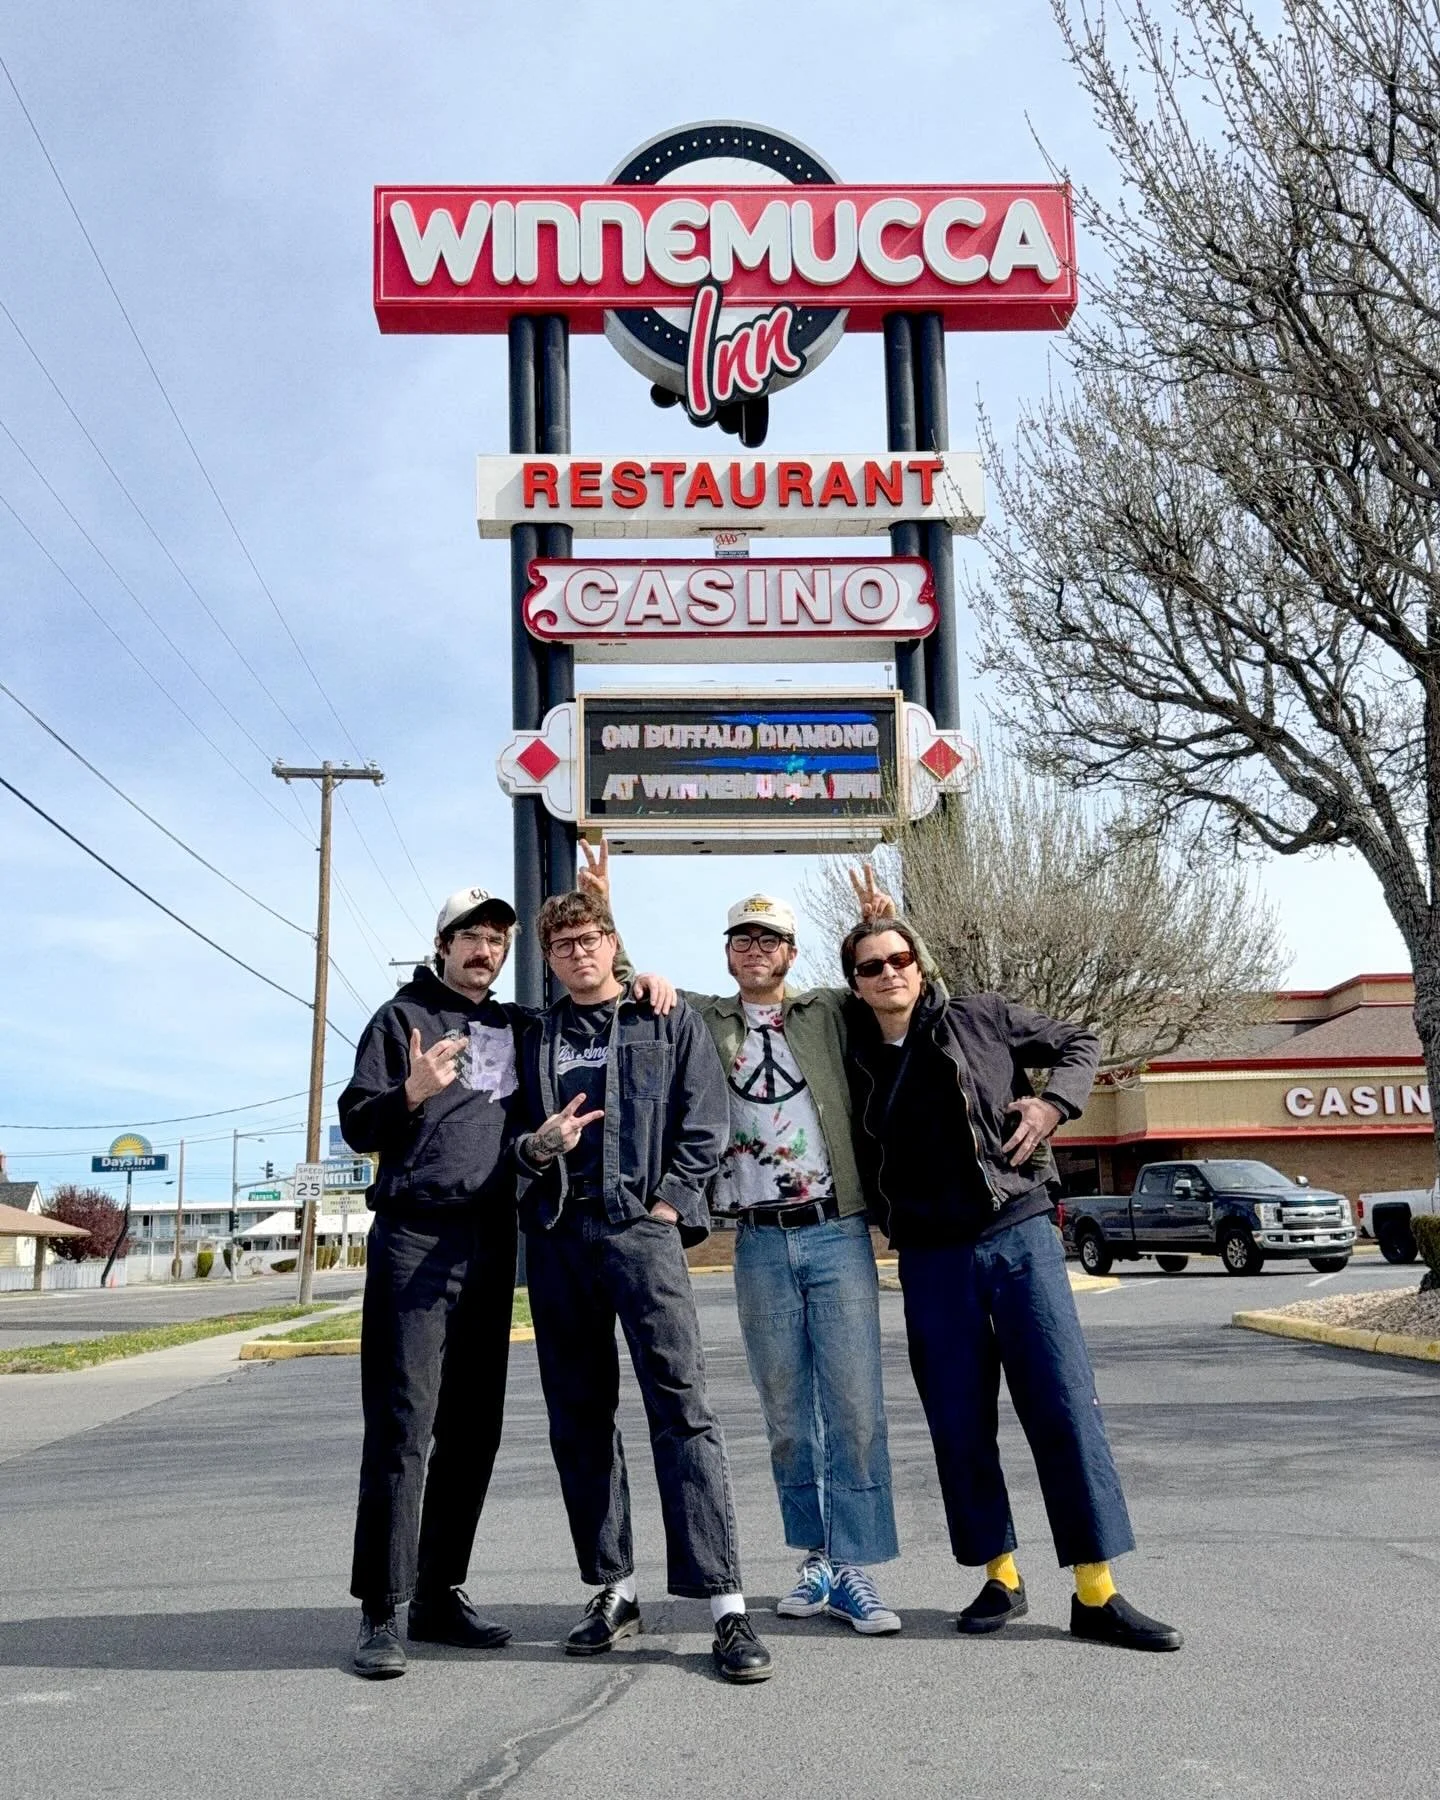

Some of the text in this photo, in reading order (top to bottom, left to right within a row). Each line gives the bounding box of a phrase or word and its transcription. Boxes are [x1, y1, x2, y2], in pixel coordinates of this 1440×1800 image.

[389, 197, 1061, 287] WINNEMUCCA
[685, 284, 803, 418] Inn
[522, 459, 945, 510] RESTAURANT
[563, 566, 900, 626] CASINO
[602, 723, 880, 749] ON BUFFALO DIAMOND
[602, 773, 640, 800] AT
[296, 1182, 321, 1197] 25
[298, 1167, 323, 1175] SPEED
